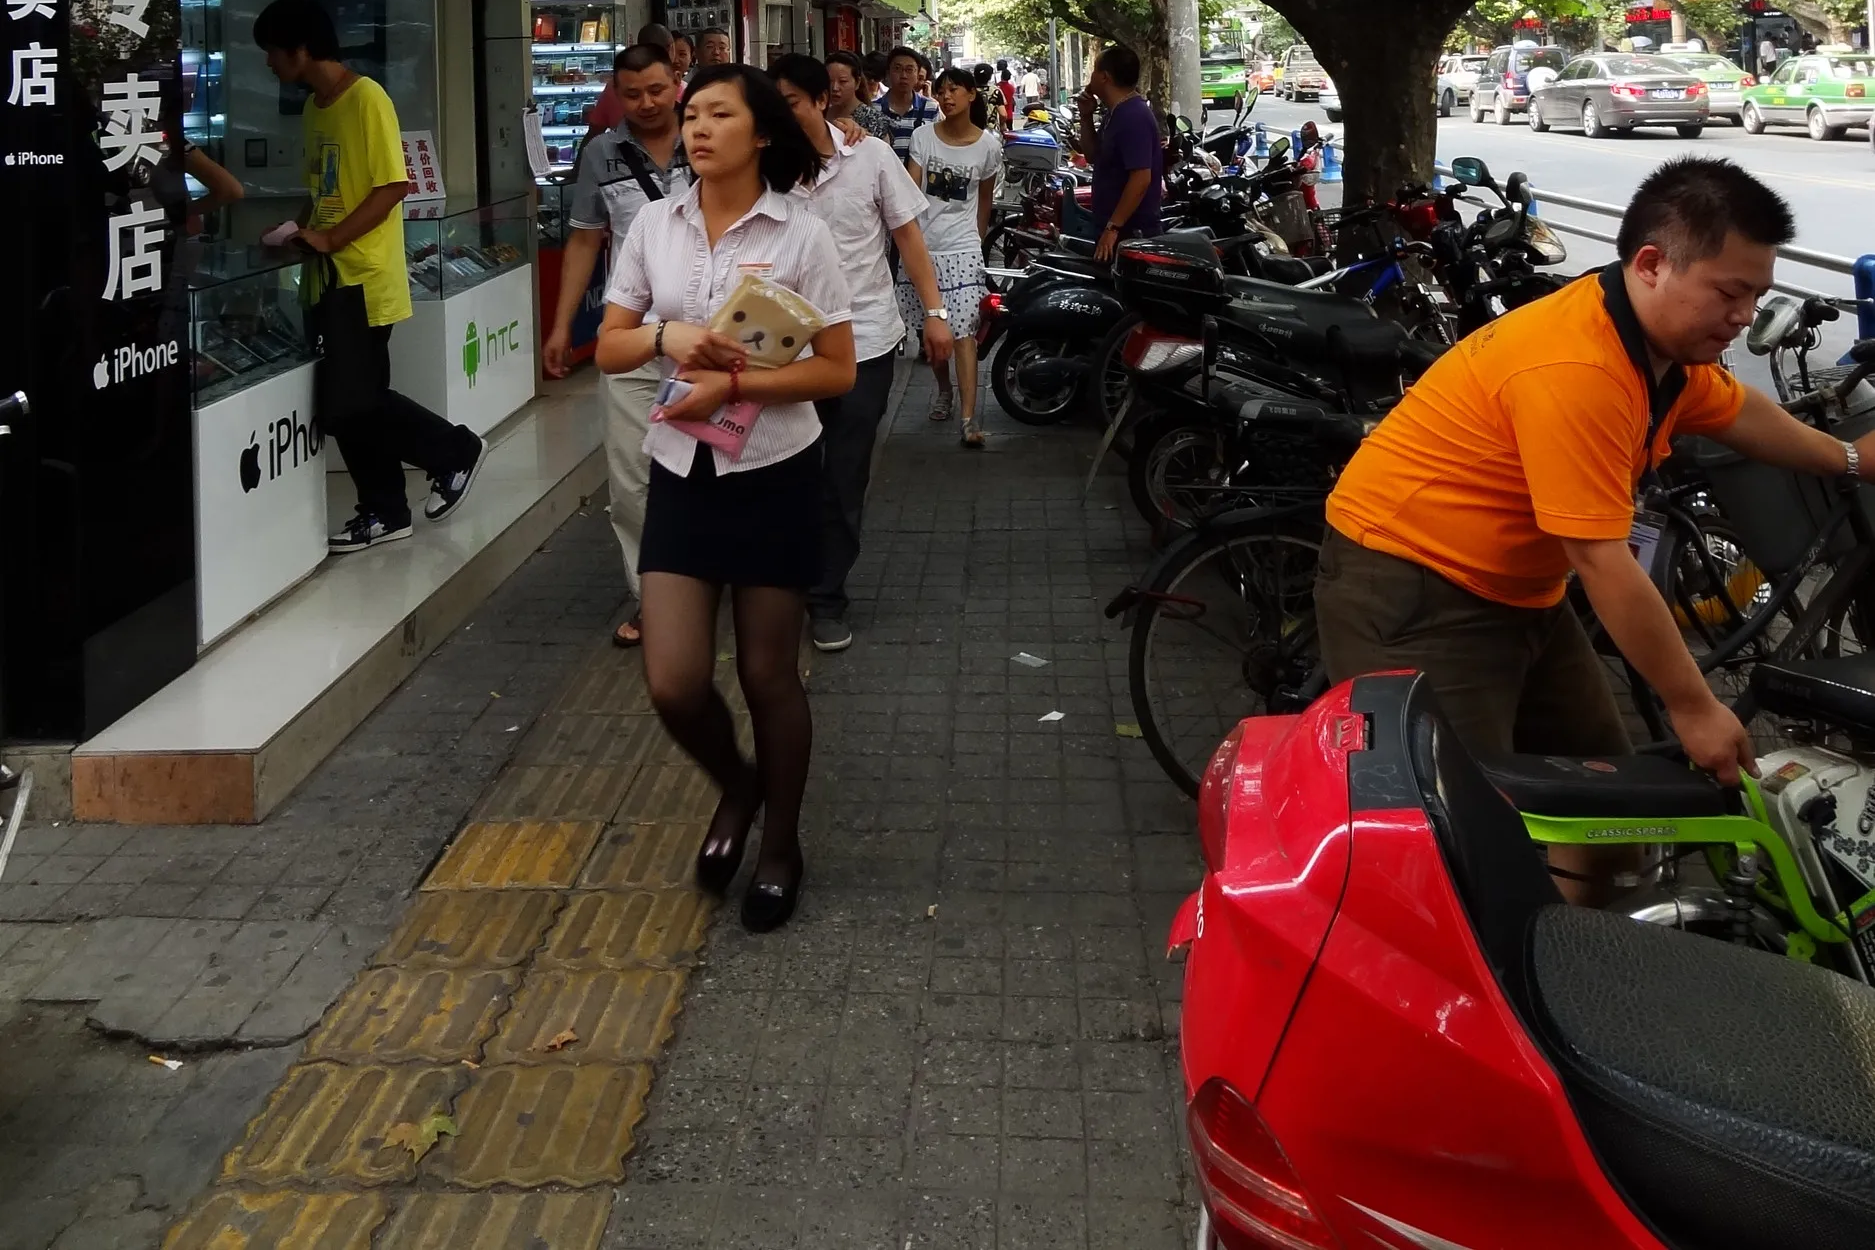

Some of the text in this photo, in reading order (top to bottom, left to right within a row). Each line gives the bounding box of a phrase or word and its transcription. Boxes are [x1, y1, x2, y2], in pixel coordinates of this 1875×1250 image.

[18, 151, 65, 167] iPhone
[415, 139, 439, 194] 高价回收
[927, 157, 974, 179] FRESH
[114, 340, 179, 389] iPhone
[268, 410, 326, 481] iPho
[1587, 828, 1634, 839] CLASSIC
